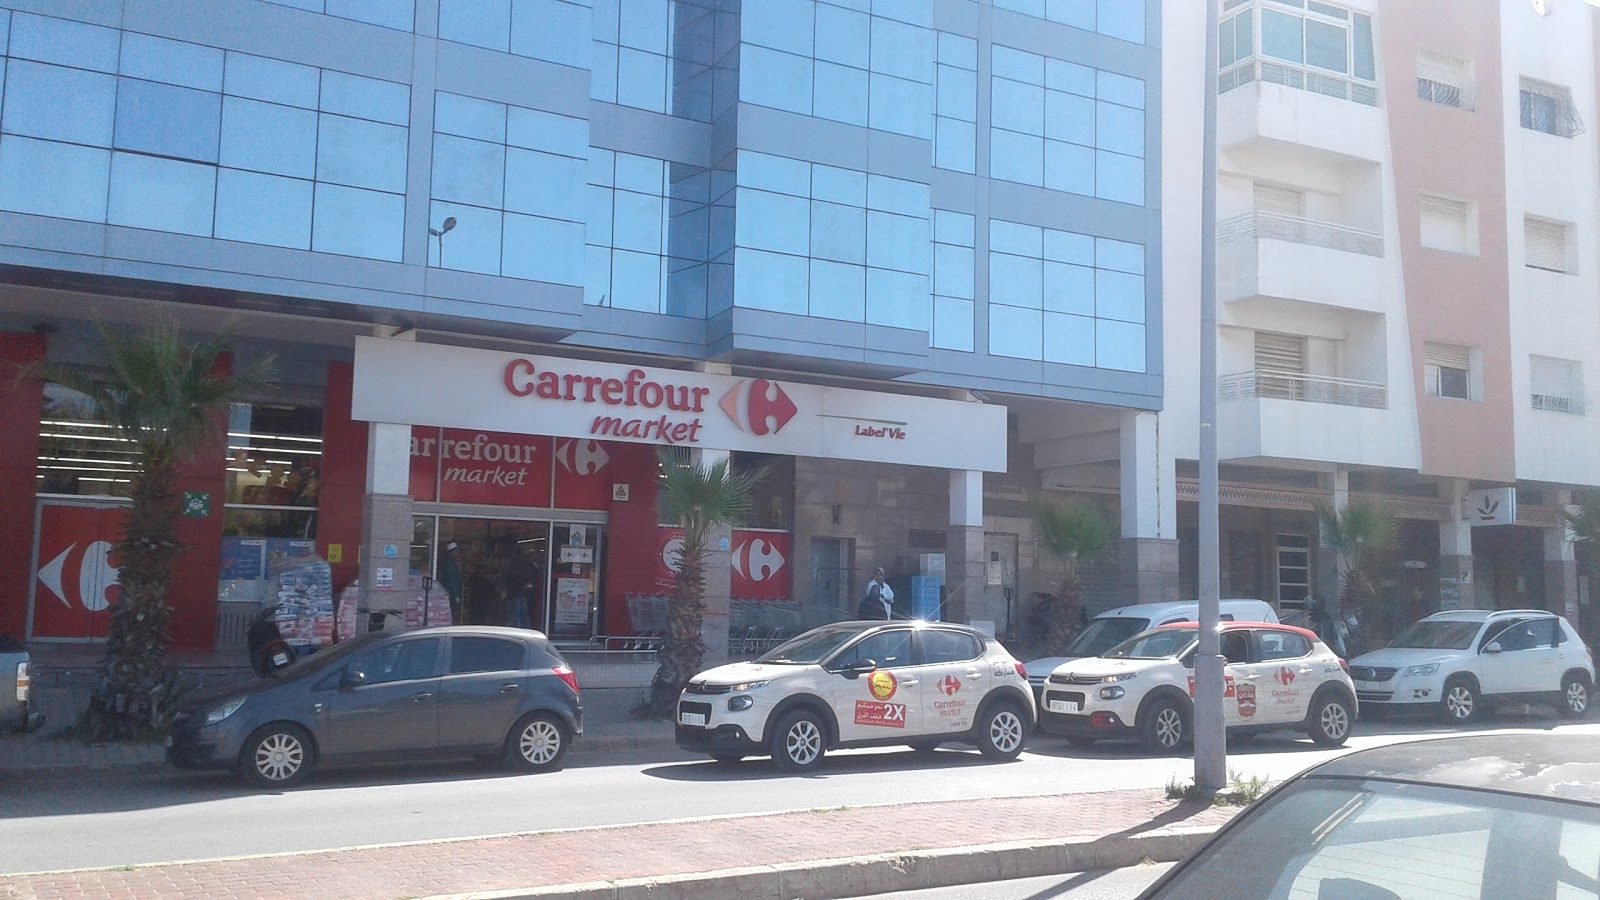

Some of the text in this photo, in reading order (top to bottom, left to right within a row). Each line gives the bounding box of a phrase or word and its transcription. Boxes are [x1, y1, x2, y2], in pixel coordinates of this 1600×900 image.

[503, 358, 710, 412] Carrefour
[590, 414, 703, 444] market
[410, 433, 537, 464] arrefour
[444, 465, 529, 487] market
[883, 703, 904, 720] 2X
